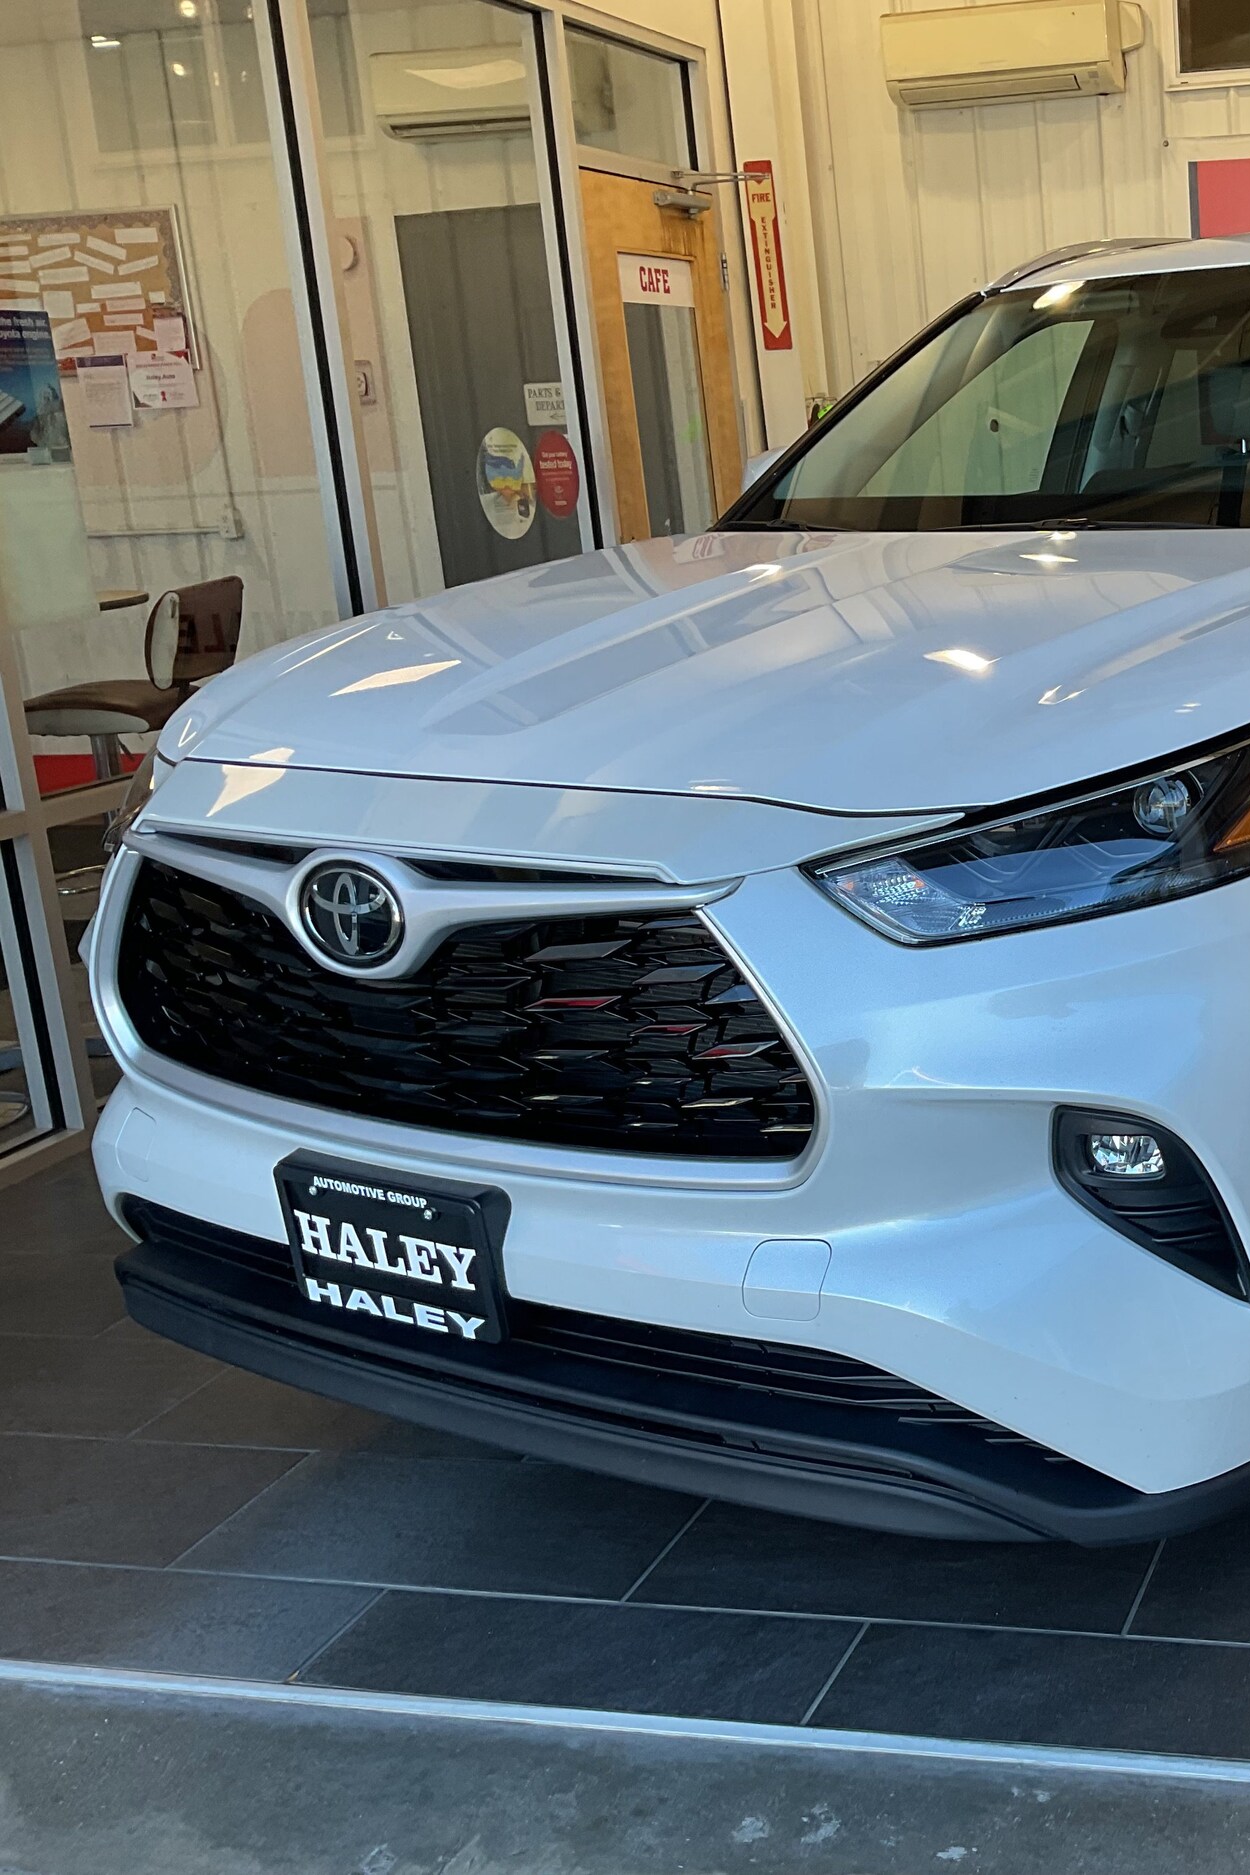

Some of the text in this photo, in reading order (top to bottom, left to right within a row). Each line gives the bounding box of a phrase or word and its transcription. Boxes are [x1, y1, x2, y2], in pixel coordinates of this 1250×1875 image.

[752, 192, 771, 203] FIRE
[761, 216, 776, 309] EXTINGUISHER
[639, 266, 670, 294] CAFE
[527, 388, 553, 398] PARTS
[313, 1175, 428, 1209] AUTOMOTIVE GROUP
[294, 1209, 477, 1291] HALEY
[305, 1277, 486, 1340] HALEY
